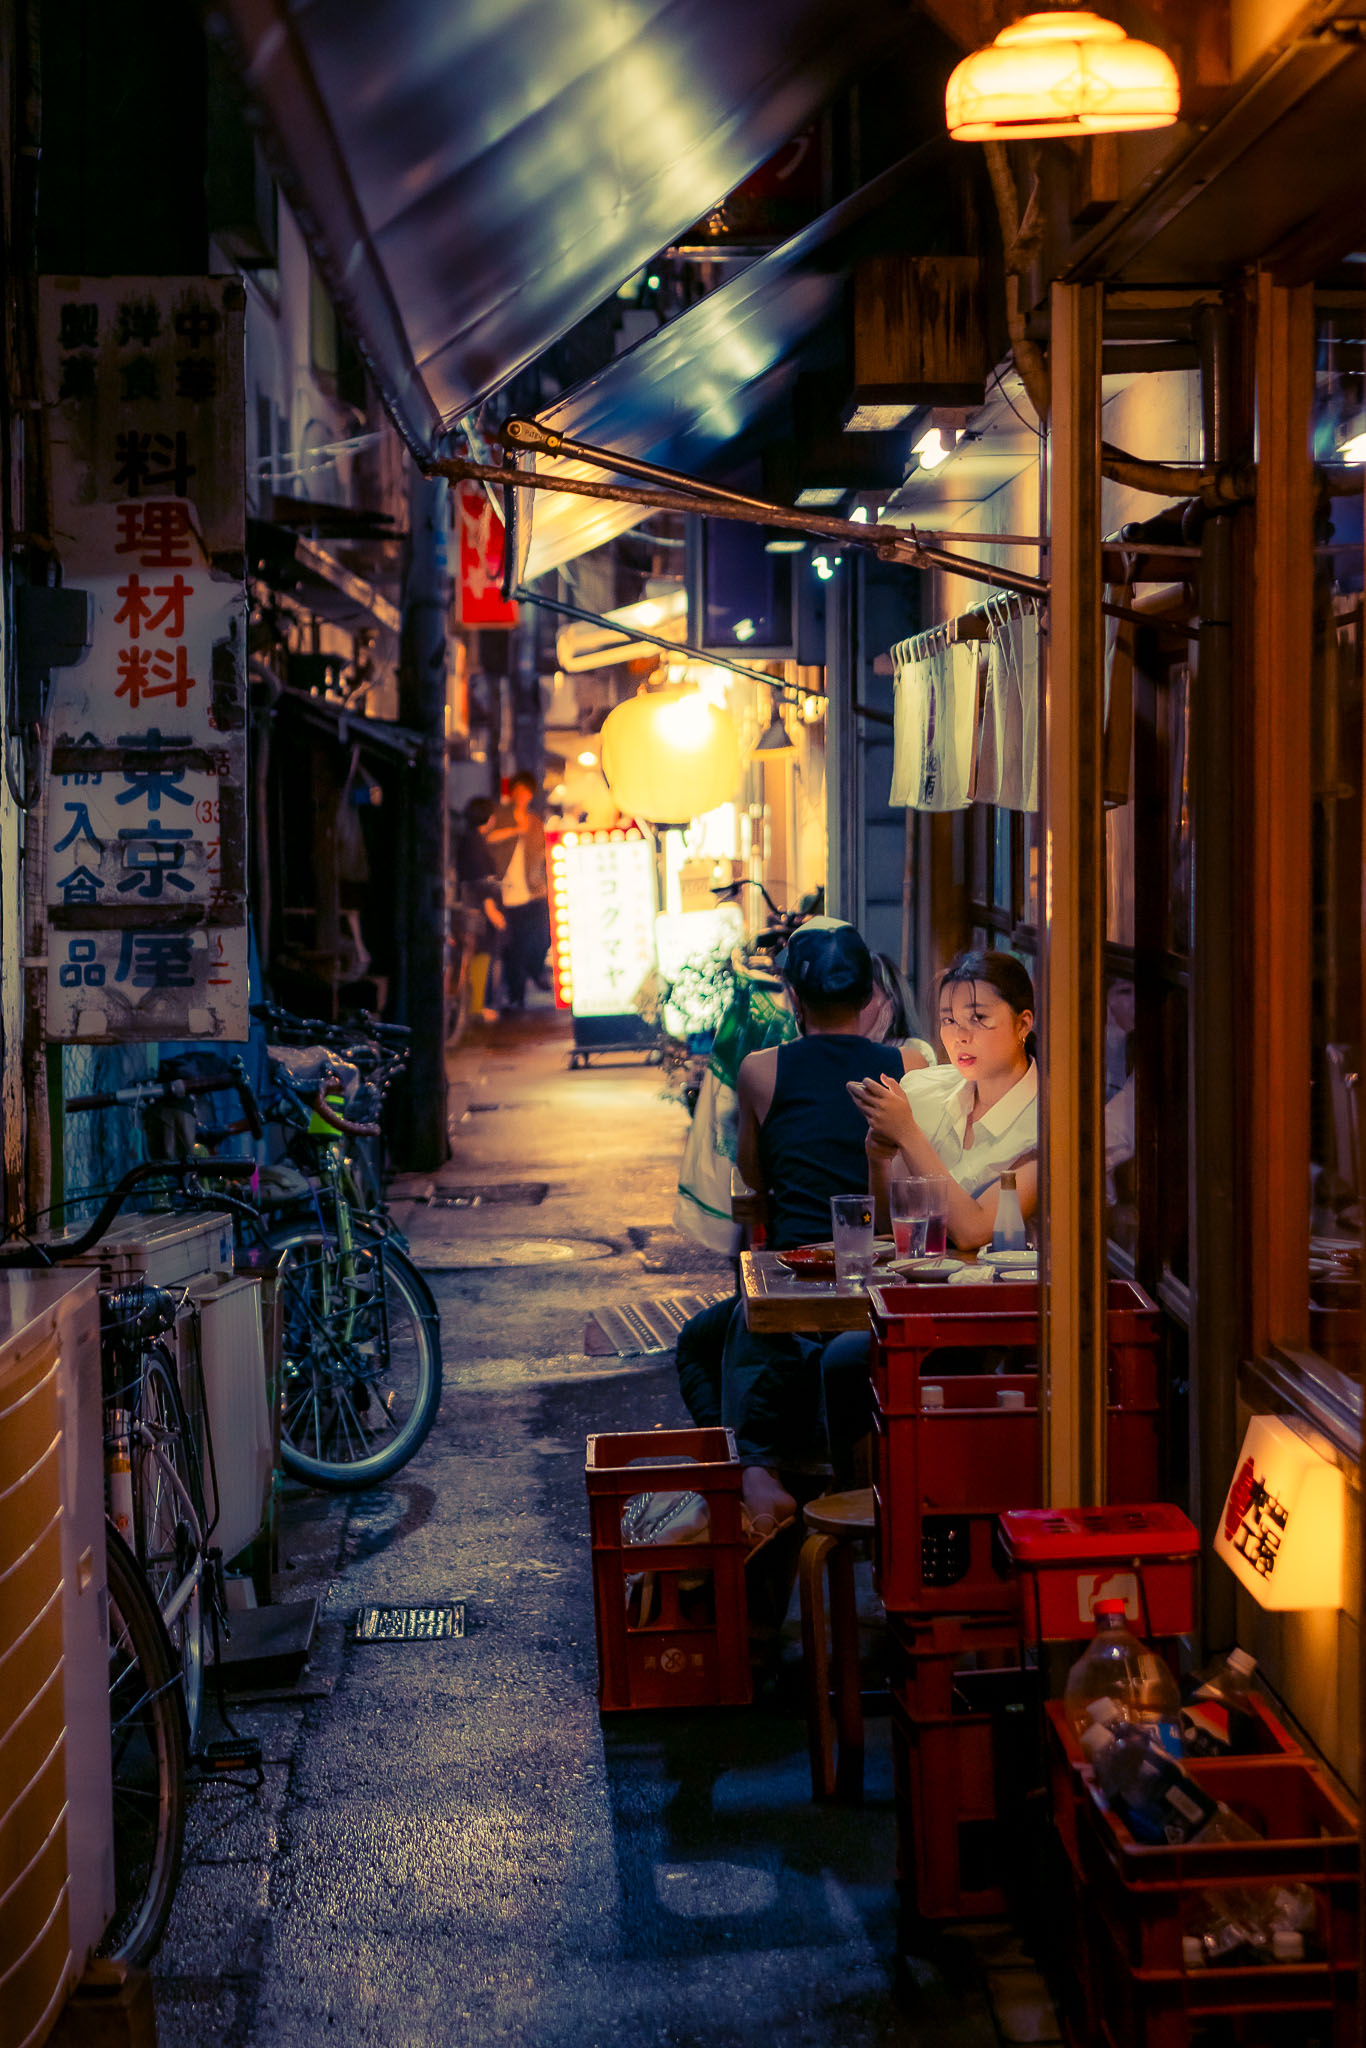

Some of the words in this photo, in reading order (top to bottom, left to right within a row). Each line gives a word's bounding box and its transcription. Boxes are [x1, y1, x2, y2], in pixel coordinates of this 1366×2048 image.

[175, 302, 216, 402] 中華
[114, 727, 196, 989] 東京屋
